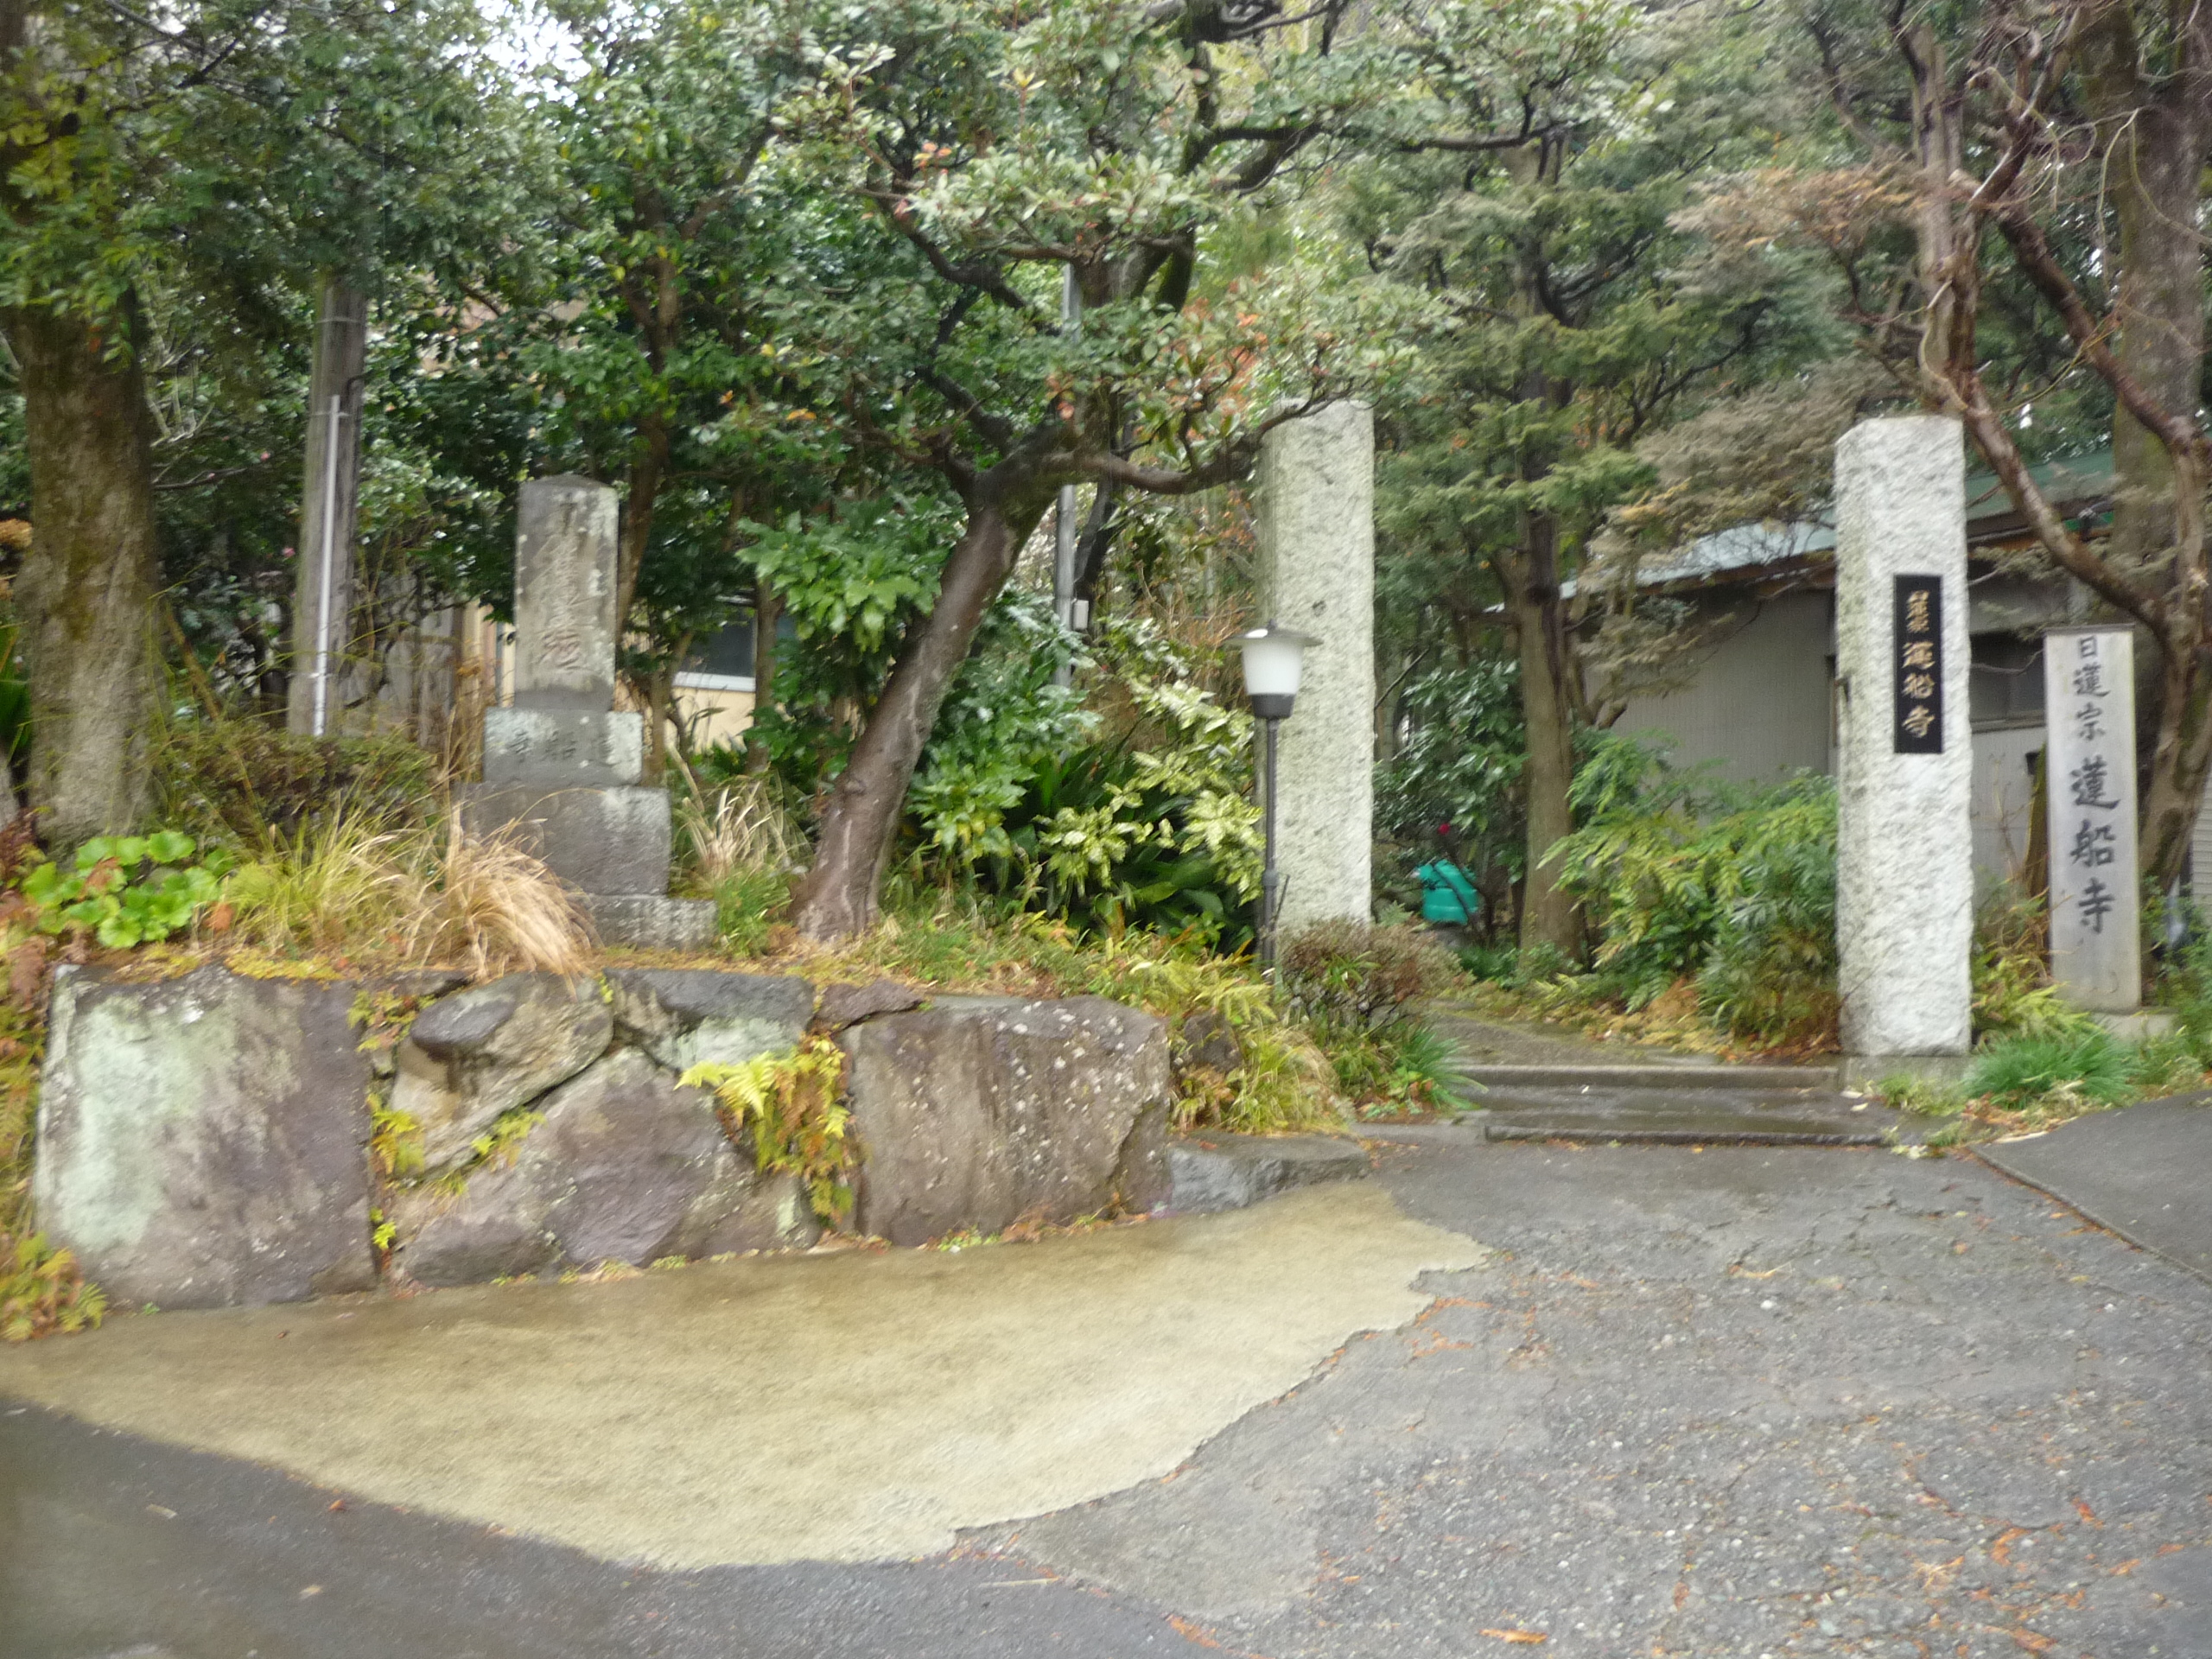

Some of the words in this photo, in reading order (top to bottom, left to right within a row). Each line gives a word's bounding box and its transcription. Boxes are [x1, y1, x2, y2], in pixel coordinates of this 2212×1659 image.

[2072, 634, 2111, 741] 日蓮宗
[2069, 755, 2120, 934] 蓮船寺
